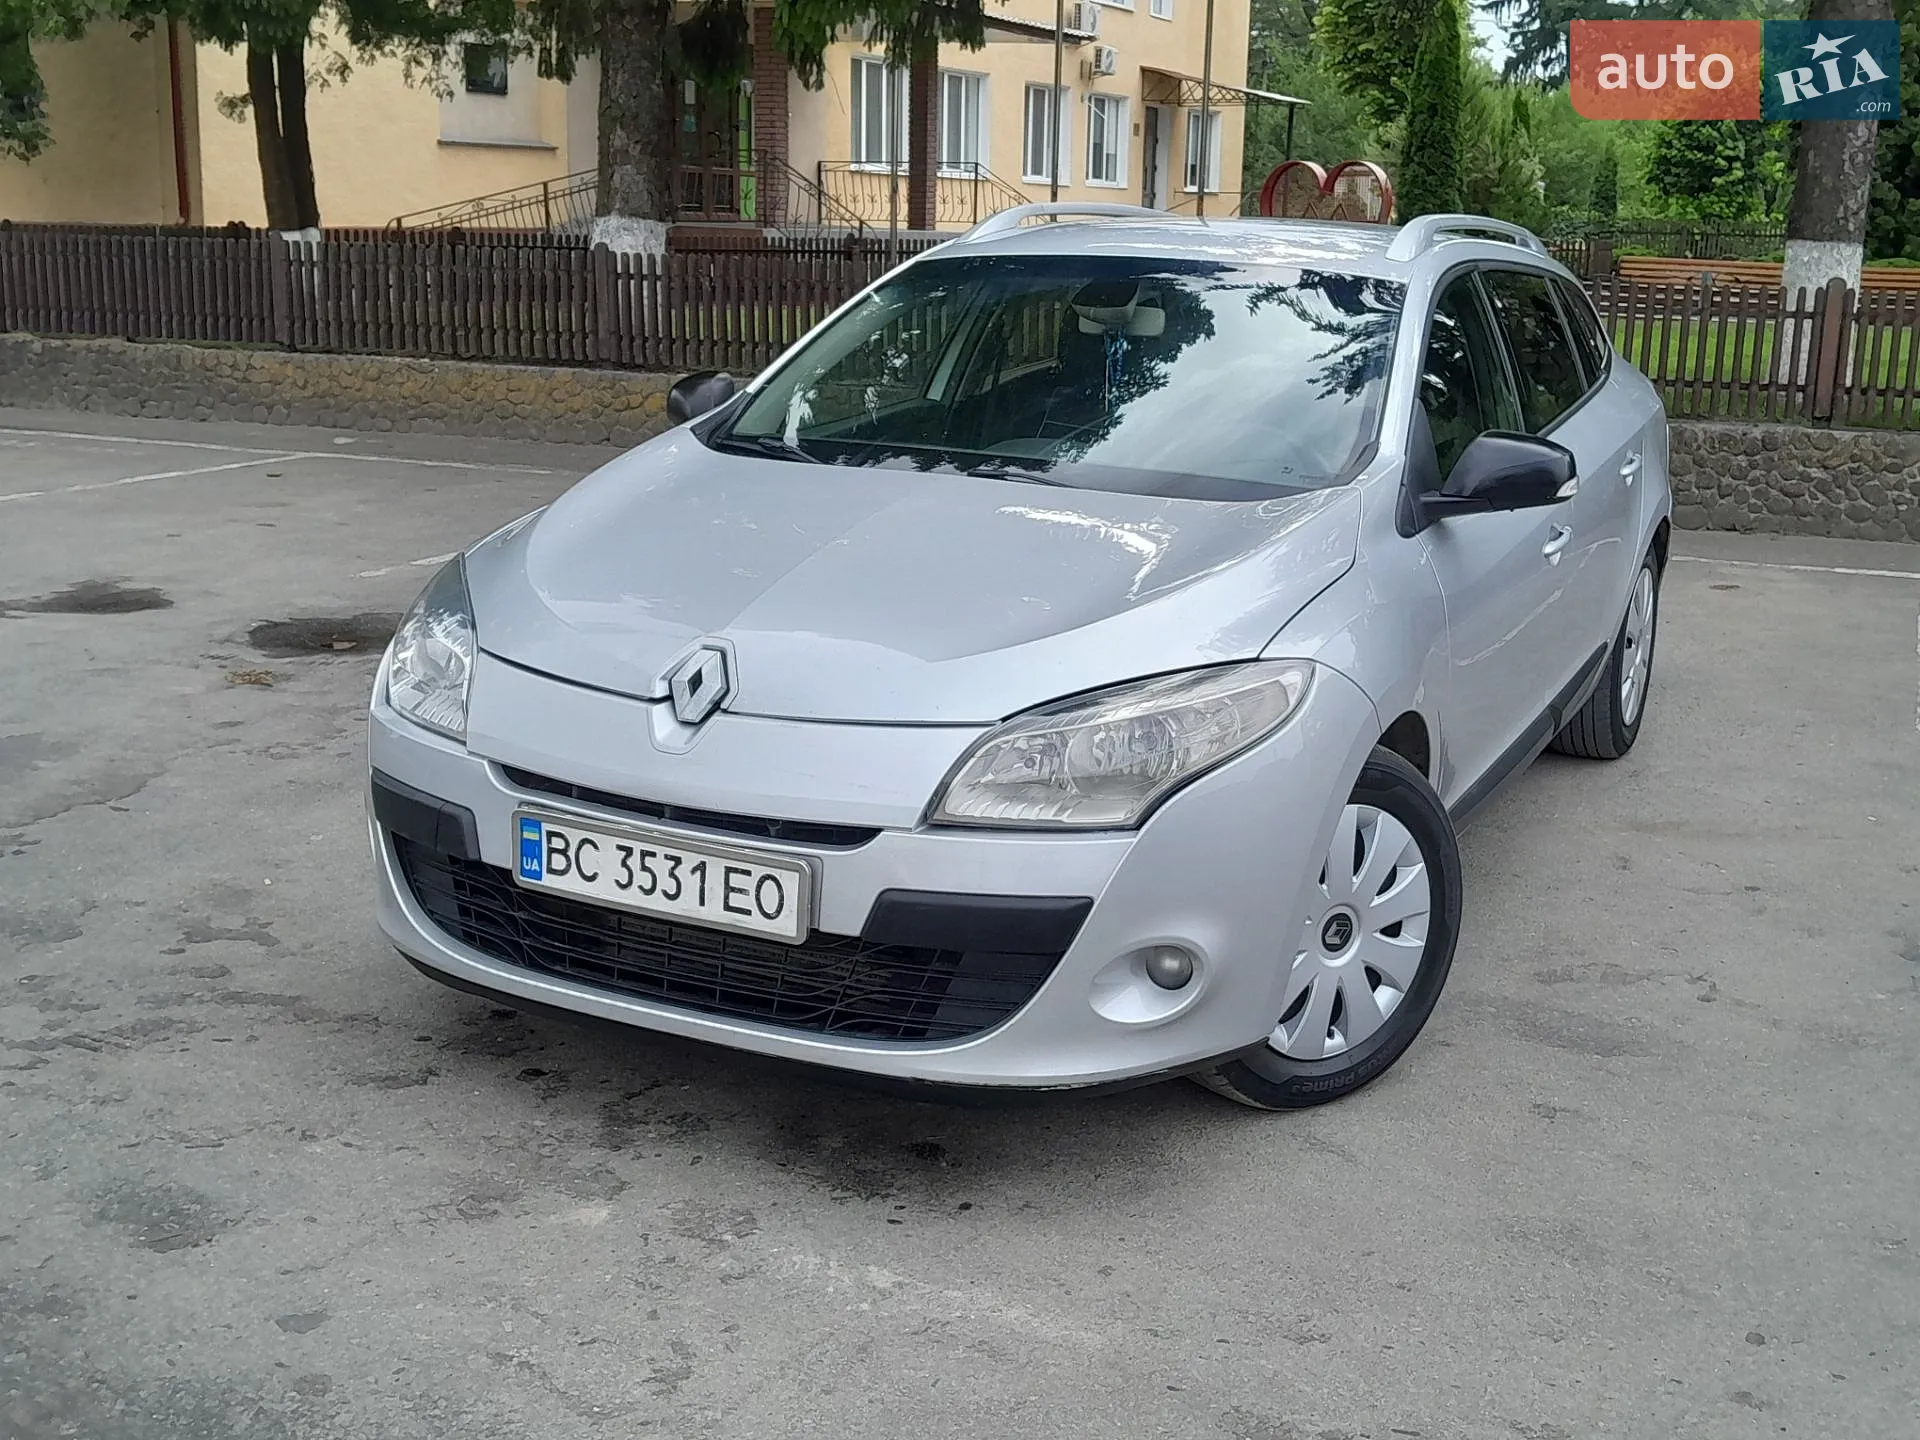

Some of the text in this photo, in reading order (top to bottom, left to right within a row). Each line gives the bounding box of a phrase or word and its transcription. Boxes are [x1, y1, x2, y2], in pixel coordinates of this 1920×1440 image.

[523, 856, 540, 872] UA
[545, 829, 785, 920] BC 3531 EO
